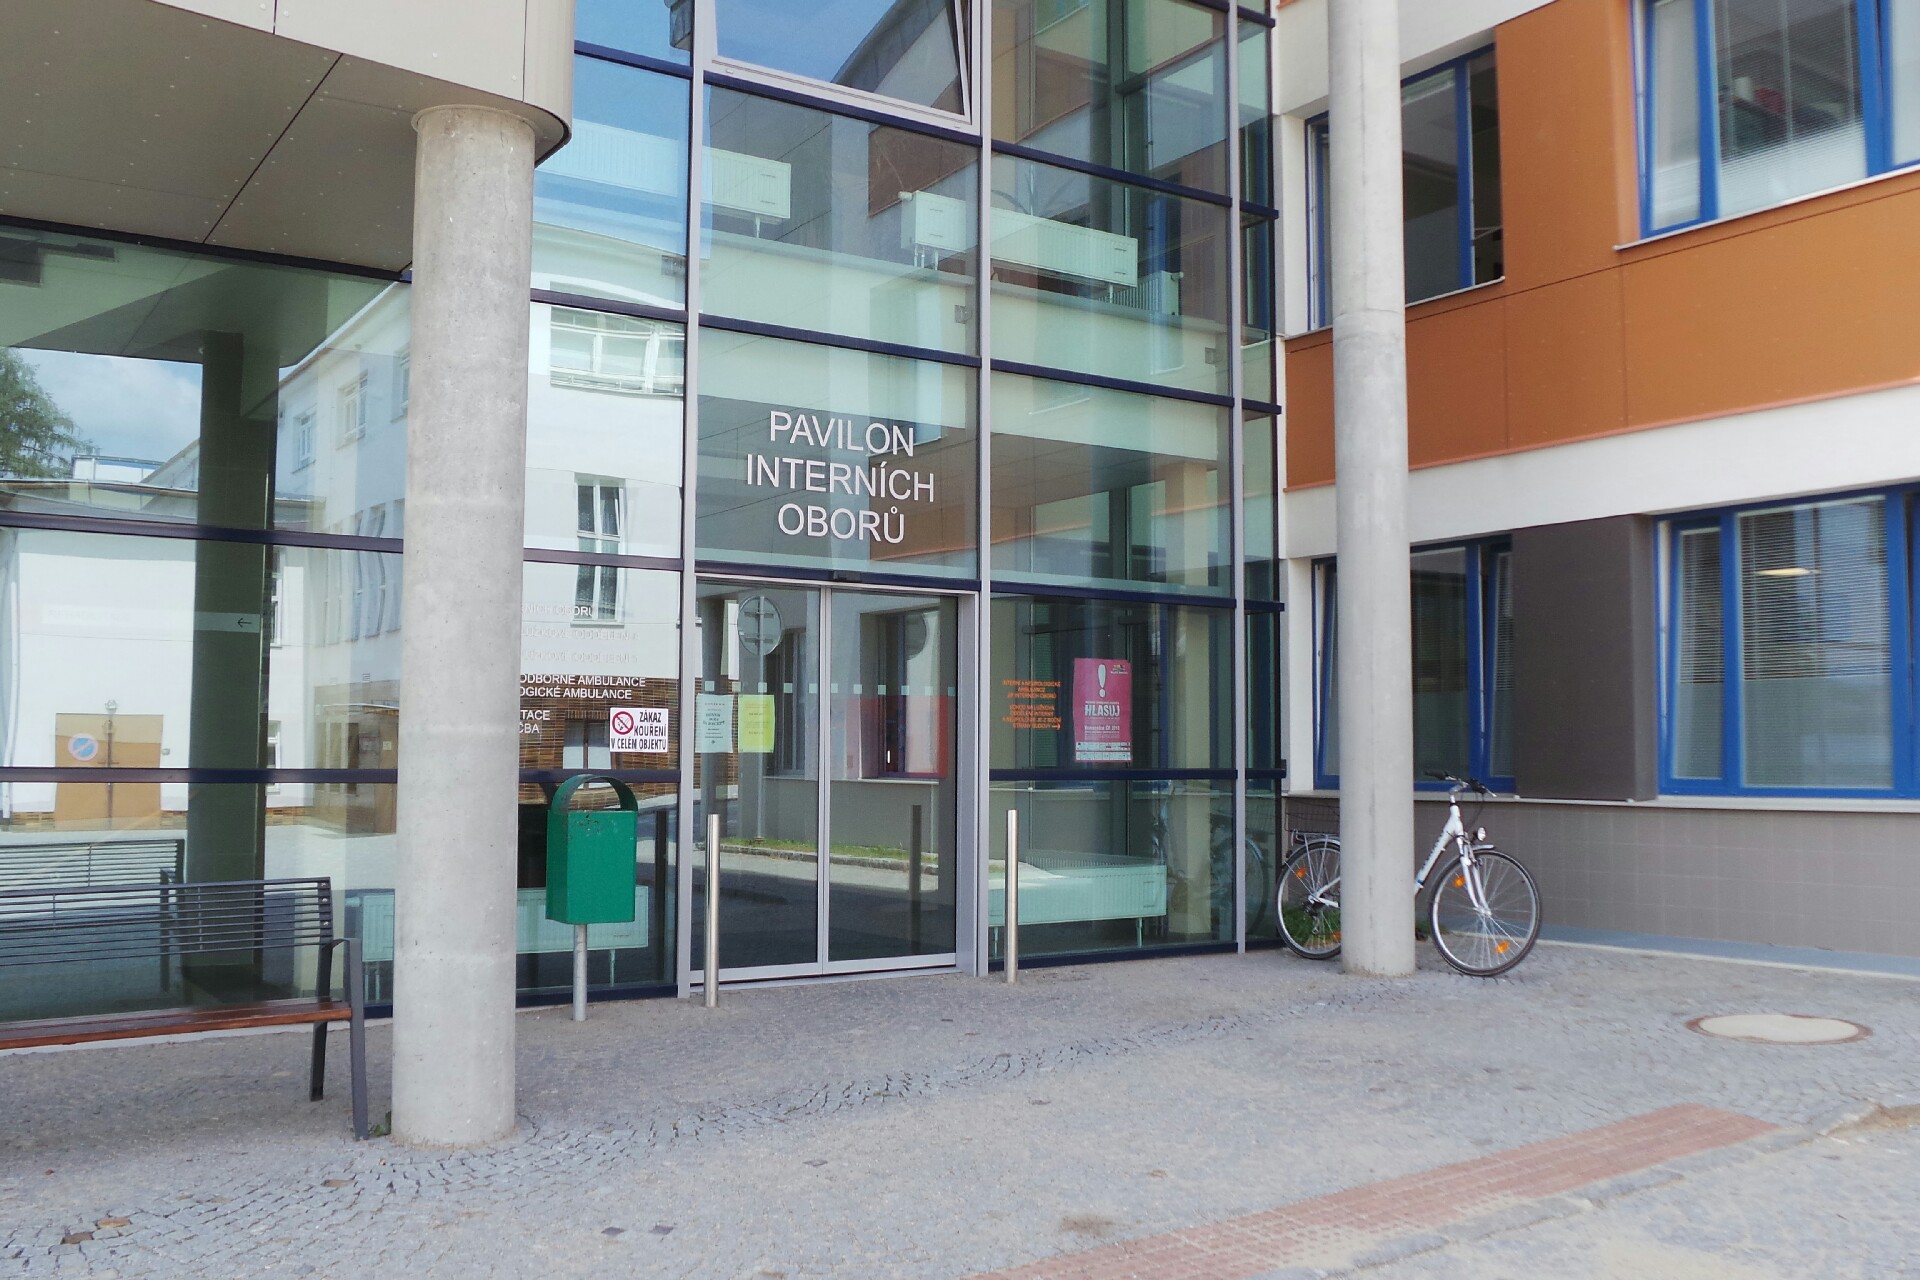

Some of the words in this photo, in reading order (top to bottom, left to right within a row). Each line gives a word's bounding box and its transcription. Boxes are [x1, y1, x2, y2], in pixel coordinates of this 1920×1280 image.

[770, 410, 914, 457] PAVILON
[747, 453, 934, 502] INTERNÍCH
[778, 503, 905, 544] OBORŮ
[578, 675, 646, 687] AMBULANCE
[563, 688, 632, 699] AMBULANCE
[520, 709, 551, 721] TACE
[639, 709, 662, 723] ZÁKAZ
[1084, 704, 1120, 717] HLASUJ
[633, 723, 667, 737] KOUŘENÍ
[610, 738, 616, 749] V
[617, 737, 637, 750] CELÉM
[639, 738, 667, 750] OBJEKTU
